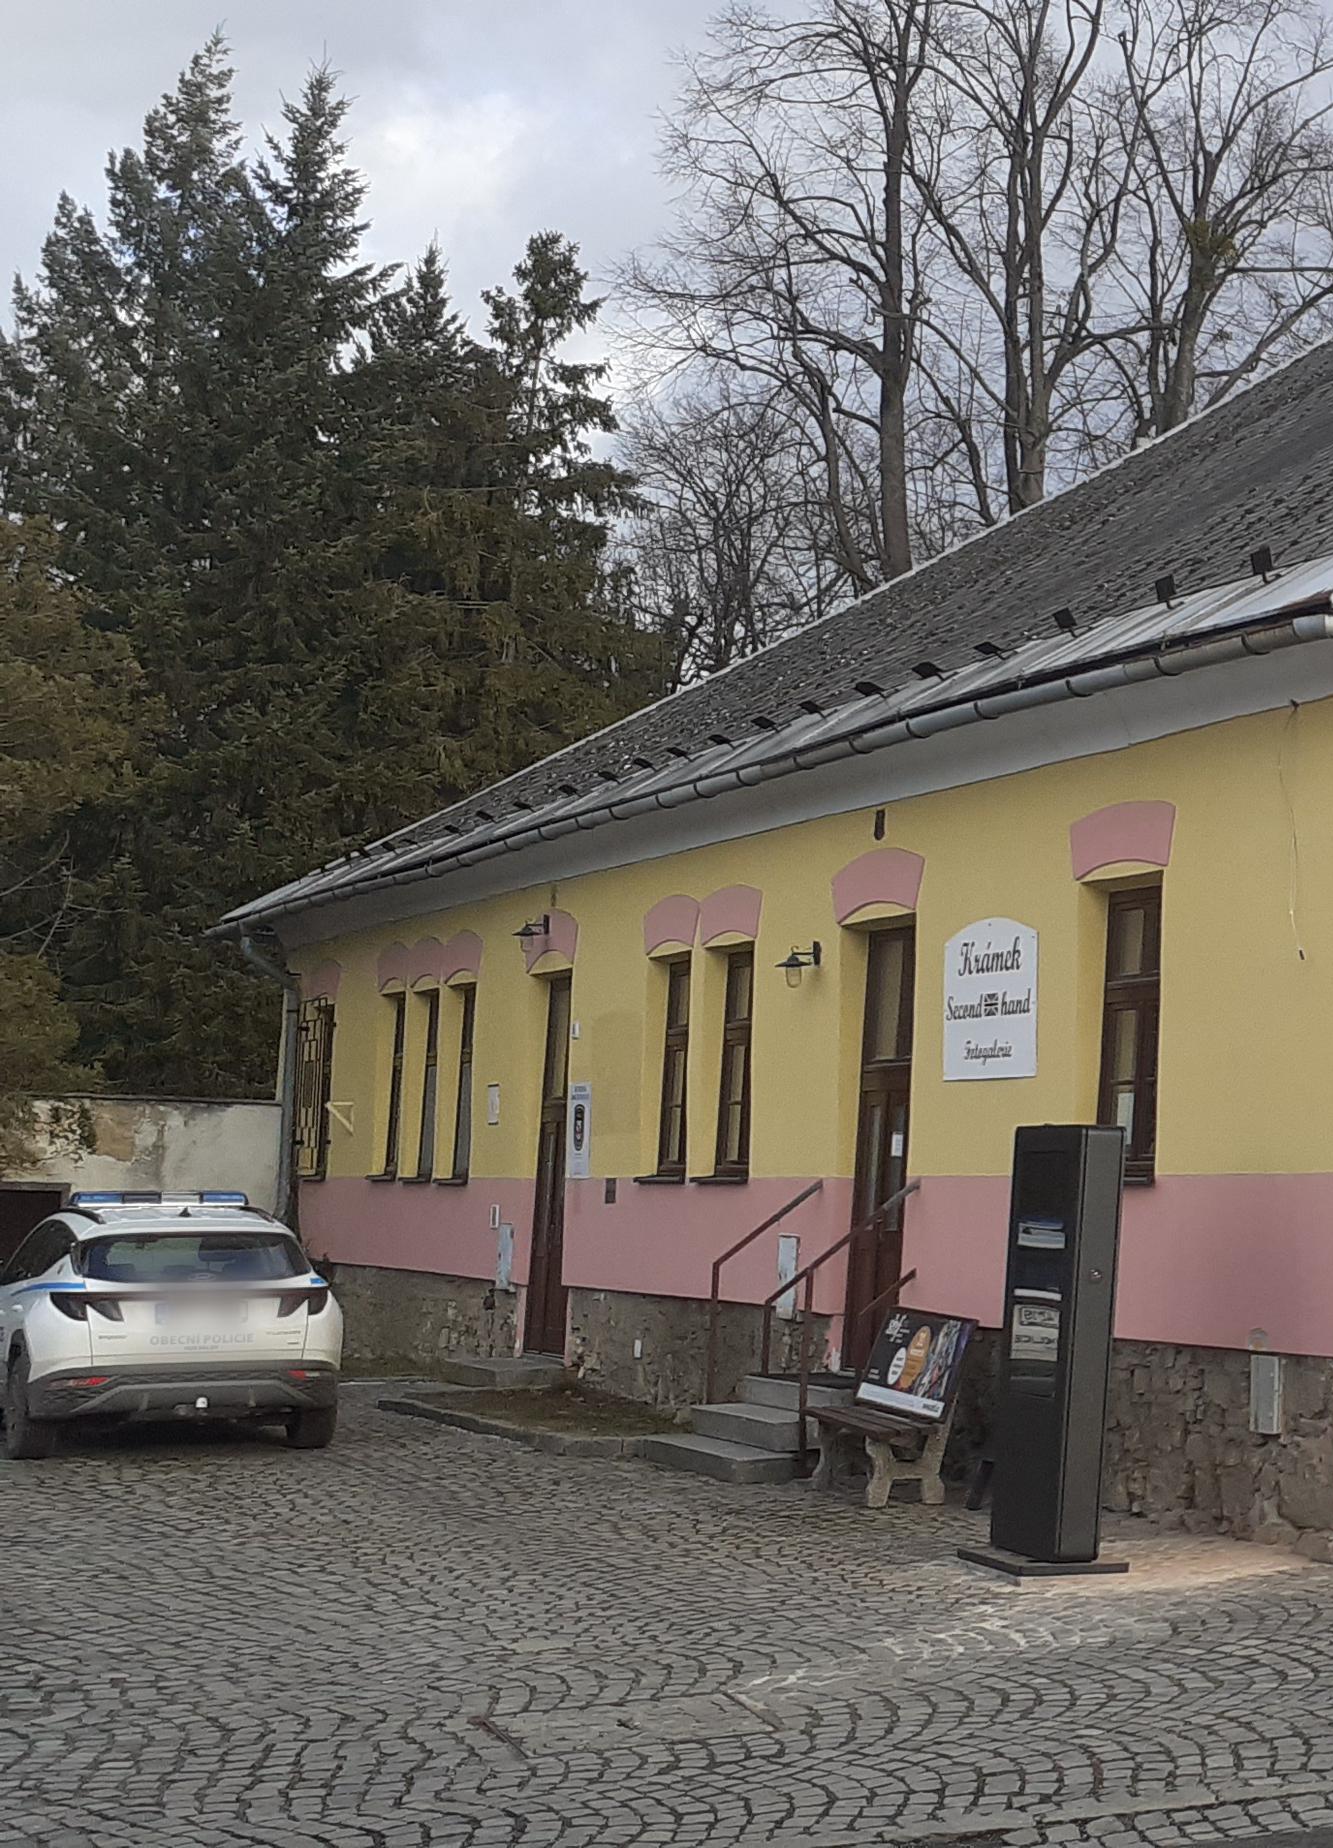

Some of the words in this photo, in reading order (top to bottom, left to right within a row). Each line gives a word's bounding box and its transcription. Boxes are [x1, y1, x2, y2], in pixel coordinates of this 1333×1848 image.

[958, 936, 1023, 976] Krámek
[948, 994, 983, 1020] Second
[1001, 988, 1031, 1016] hand
[203, 1333, 255, 1344] POLICIE
